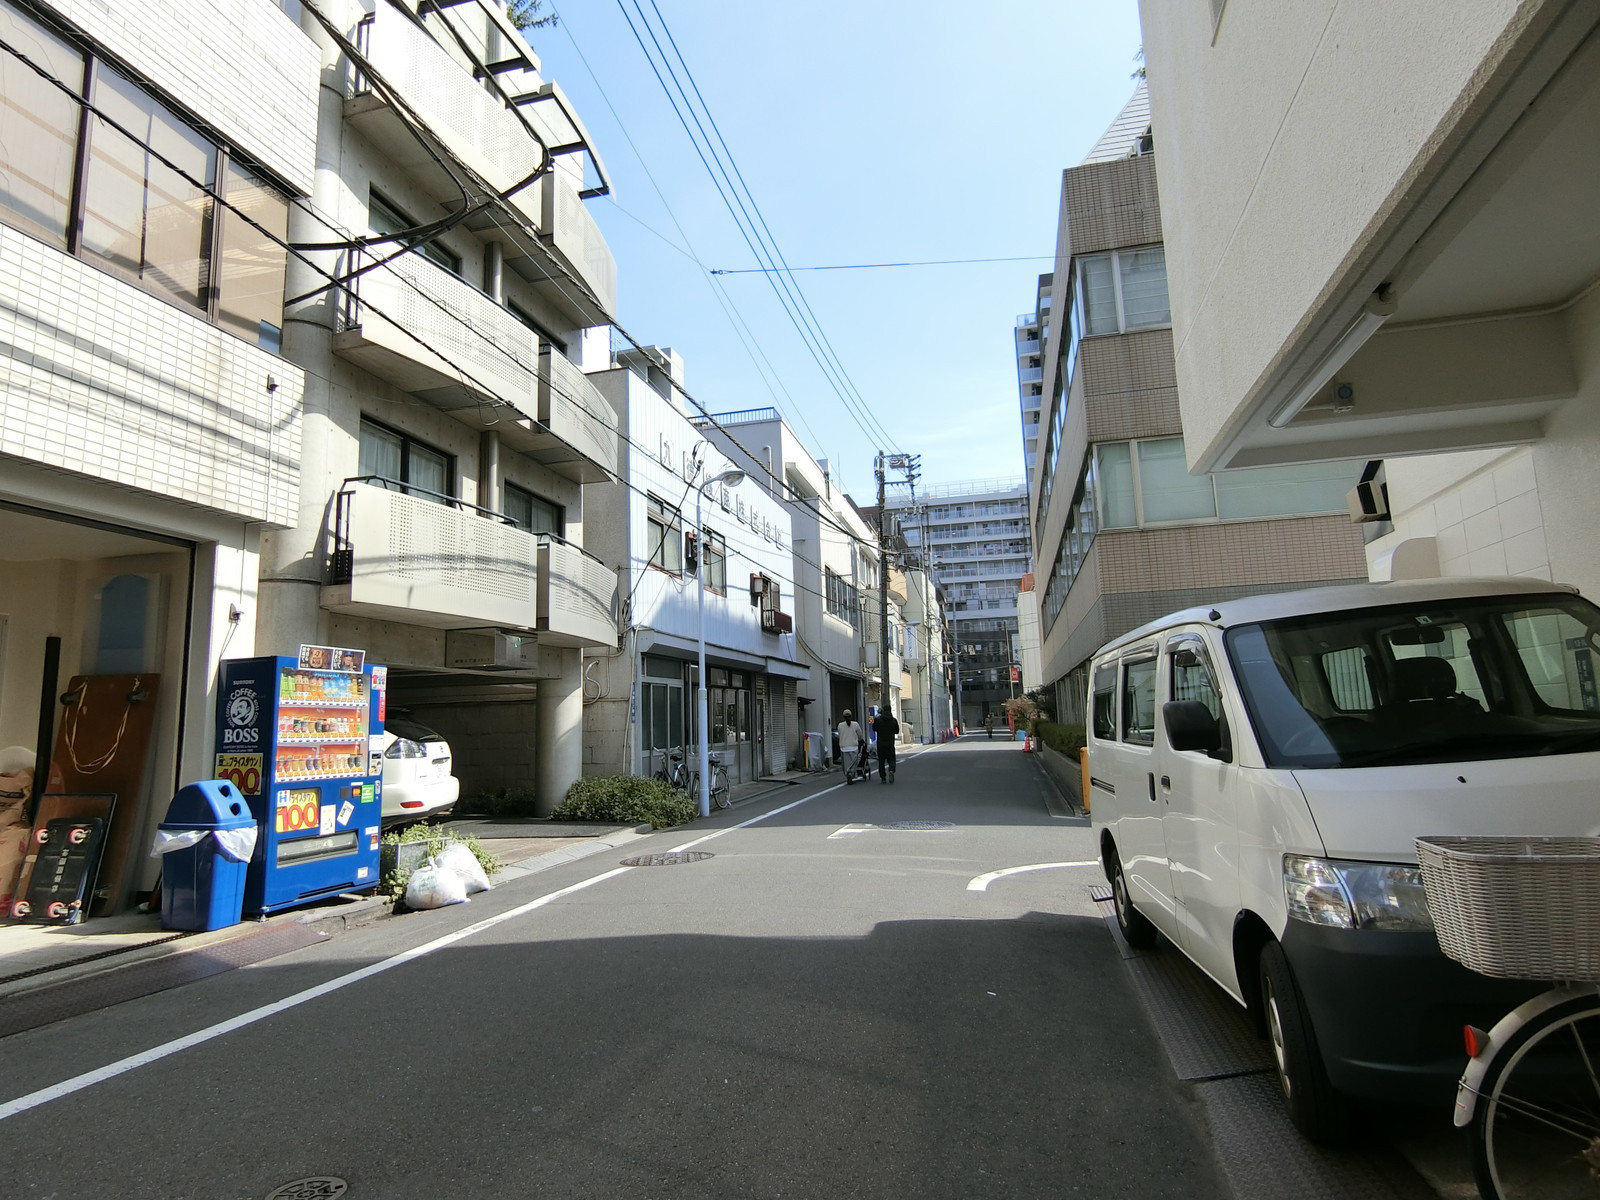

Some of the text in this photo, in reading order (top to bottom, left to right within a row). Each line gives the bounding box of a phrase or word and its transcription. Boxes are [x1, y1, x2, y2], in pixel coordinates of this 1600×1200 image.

[230, 687, 257, 700] COFFEE
[223, 728, 259, 743] BOSS
[277, 802, 319, 832] 100
